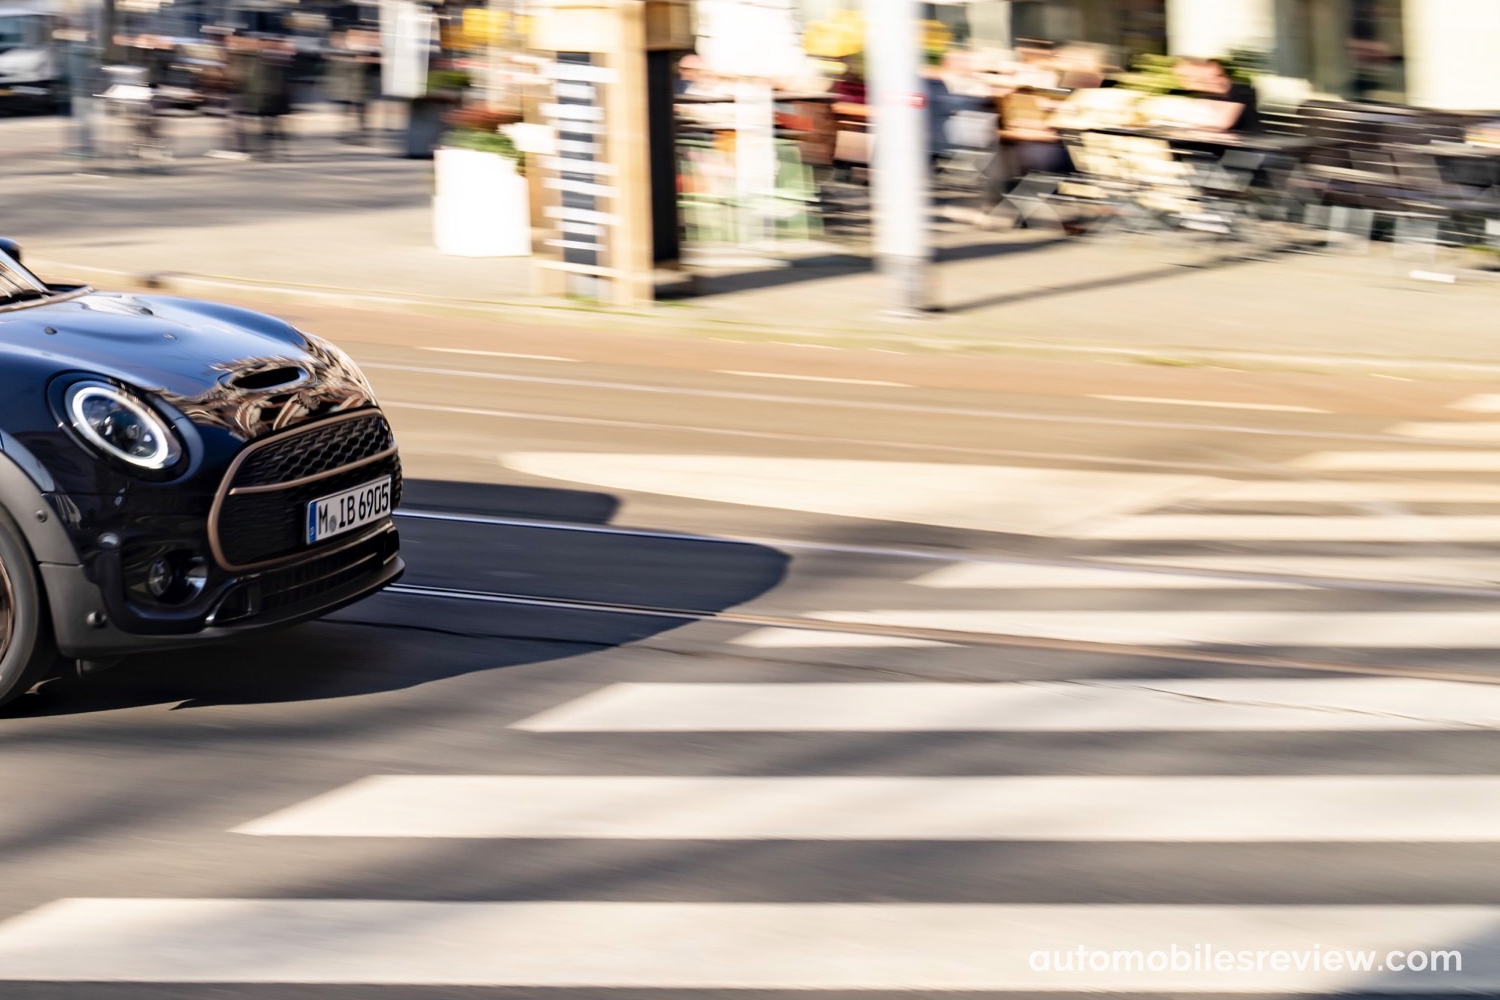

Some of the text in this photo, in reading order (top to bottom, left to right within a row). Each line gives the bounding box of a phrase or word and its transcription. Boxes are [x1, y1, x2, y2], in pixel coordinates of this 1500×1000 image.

[318, 483, 389, 535] M IB 6905
